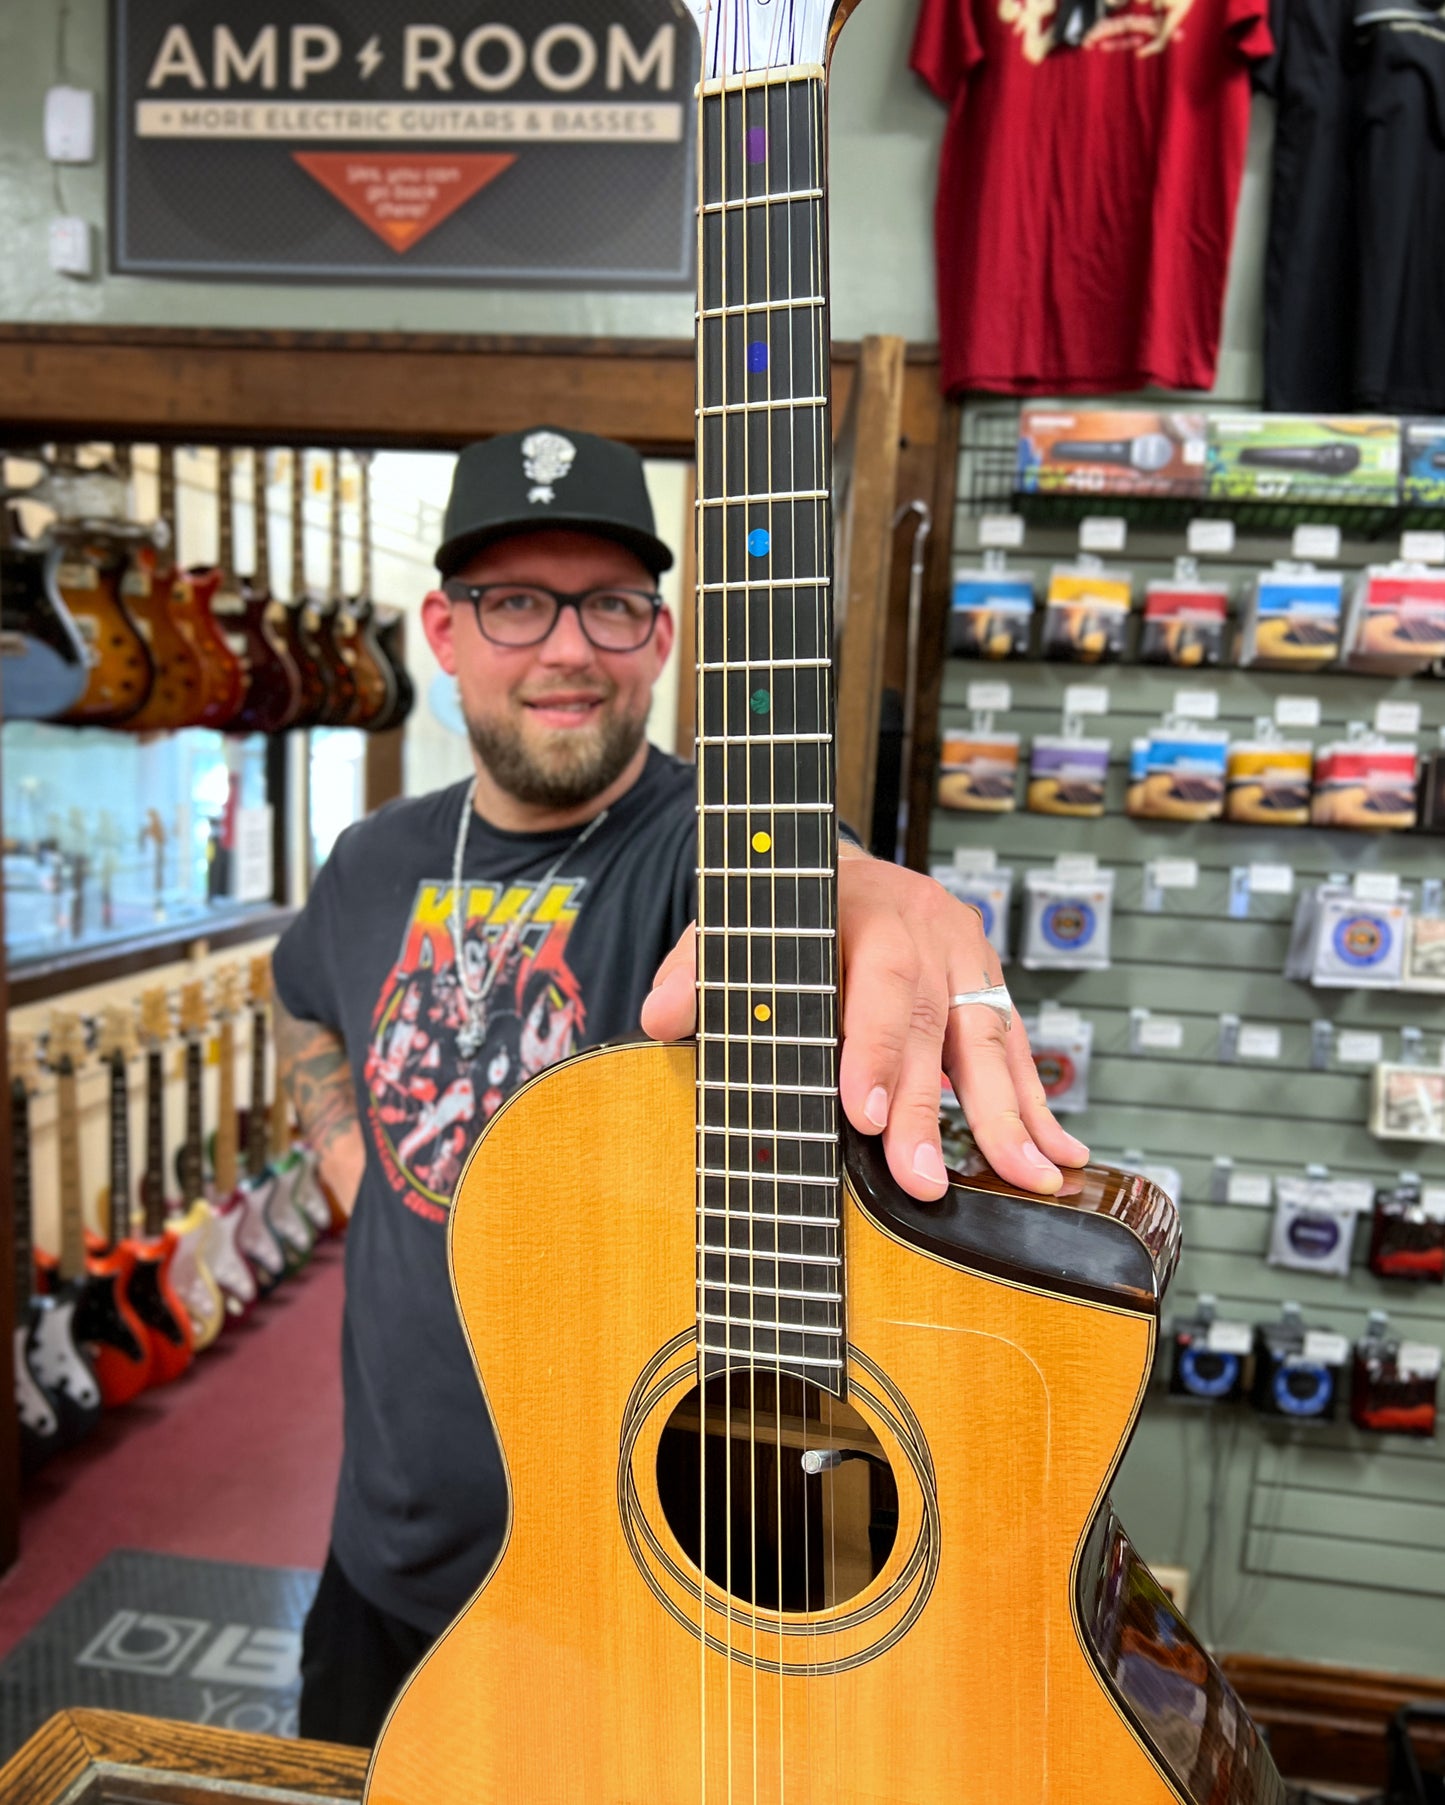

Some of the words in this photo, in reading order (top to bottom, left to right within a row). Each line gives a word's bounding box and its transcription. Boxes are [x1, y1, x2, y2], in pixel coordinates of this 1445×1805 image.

[147, 23, 341, 91] AMP
[402, 24, 676, 91] ROOM
[180, 108, 254, 129] MORE
[265, 109, 390, 131] ELECTRIC
[401, 110, 515, 131] GUITARS
[525, 111, 541, 131] &
[551, 111, 656, 132] BASSES
